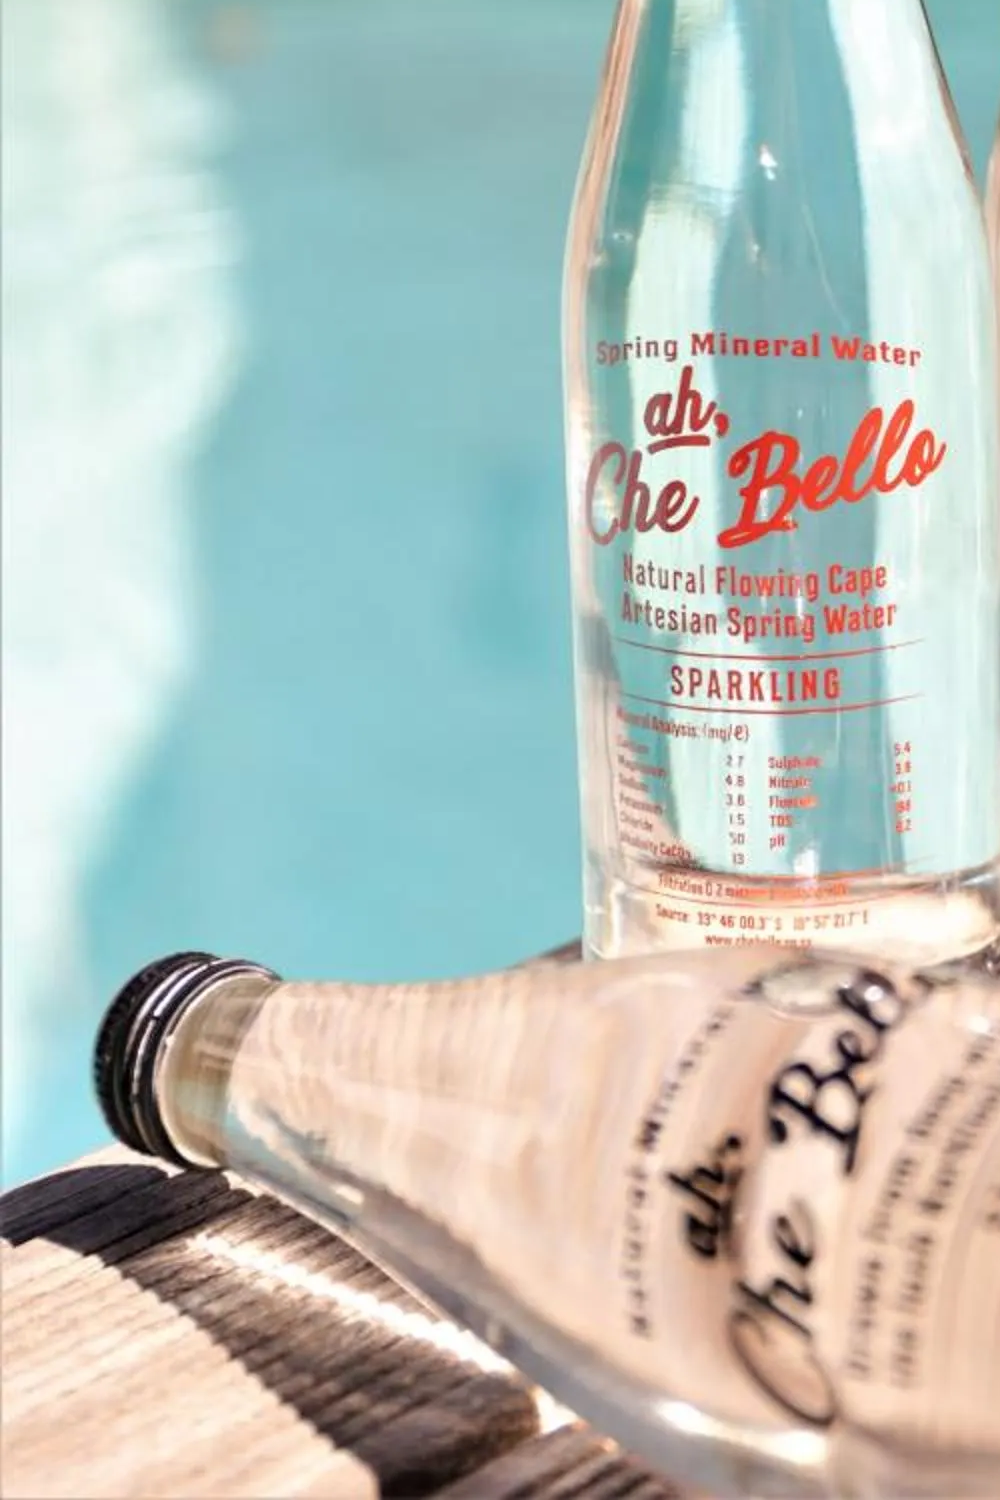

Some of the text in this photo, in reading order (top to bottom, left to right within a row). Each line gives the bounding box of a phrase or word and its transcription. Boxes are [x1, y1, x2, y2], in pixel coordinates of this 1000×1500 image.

[597, 332, 922, 367] Spring Mineral Water
[644, 365, 729, 440] ah,
[586, 398, 947, 549] Che Bello
[623, 553, 888, 601] Natural Flowing Cape
[621, 594, 898, 644] Artesian Spring Water
[670, 664, 841, 701] SPARKLING
